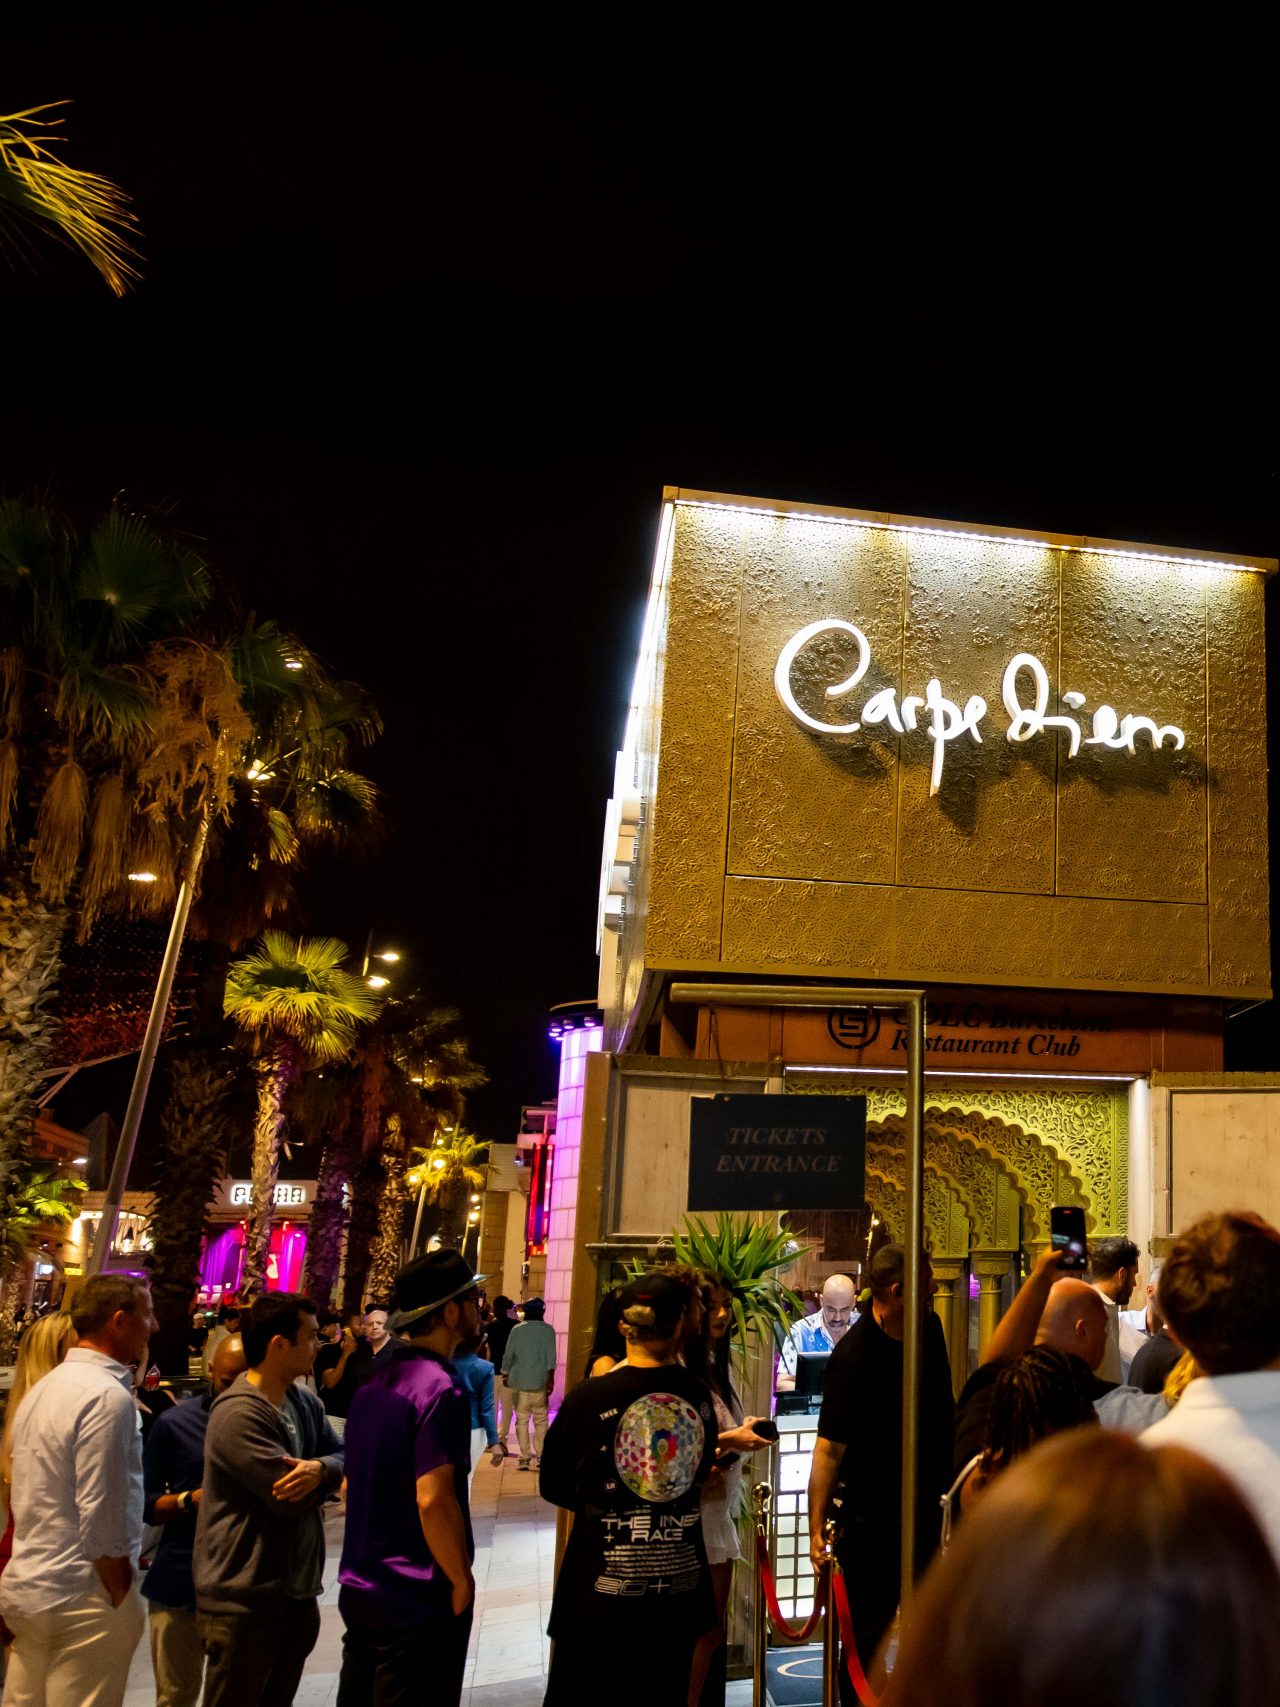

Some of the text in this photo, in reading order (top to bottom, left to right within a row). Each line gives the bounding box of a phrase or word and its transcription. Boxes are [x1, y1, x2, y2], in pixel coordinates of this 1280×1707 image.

[774, 618, 987, 797] Carpe
[890, 1029, 1081, 1057] Rstaurant Club
[727, 1126, 827, 1146] TICKETS
[715, 1153, 842, 1174] ENTRANCE
[601, 1515, 652, 1531] THE
[631, 1528, 684, 1543] RACE
